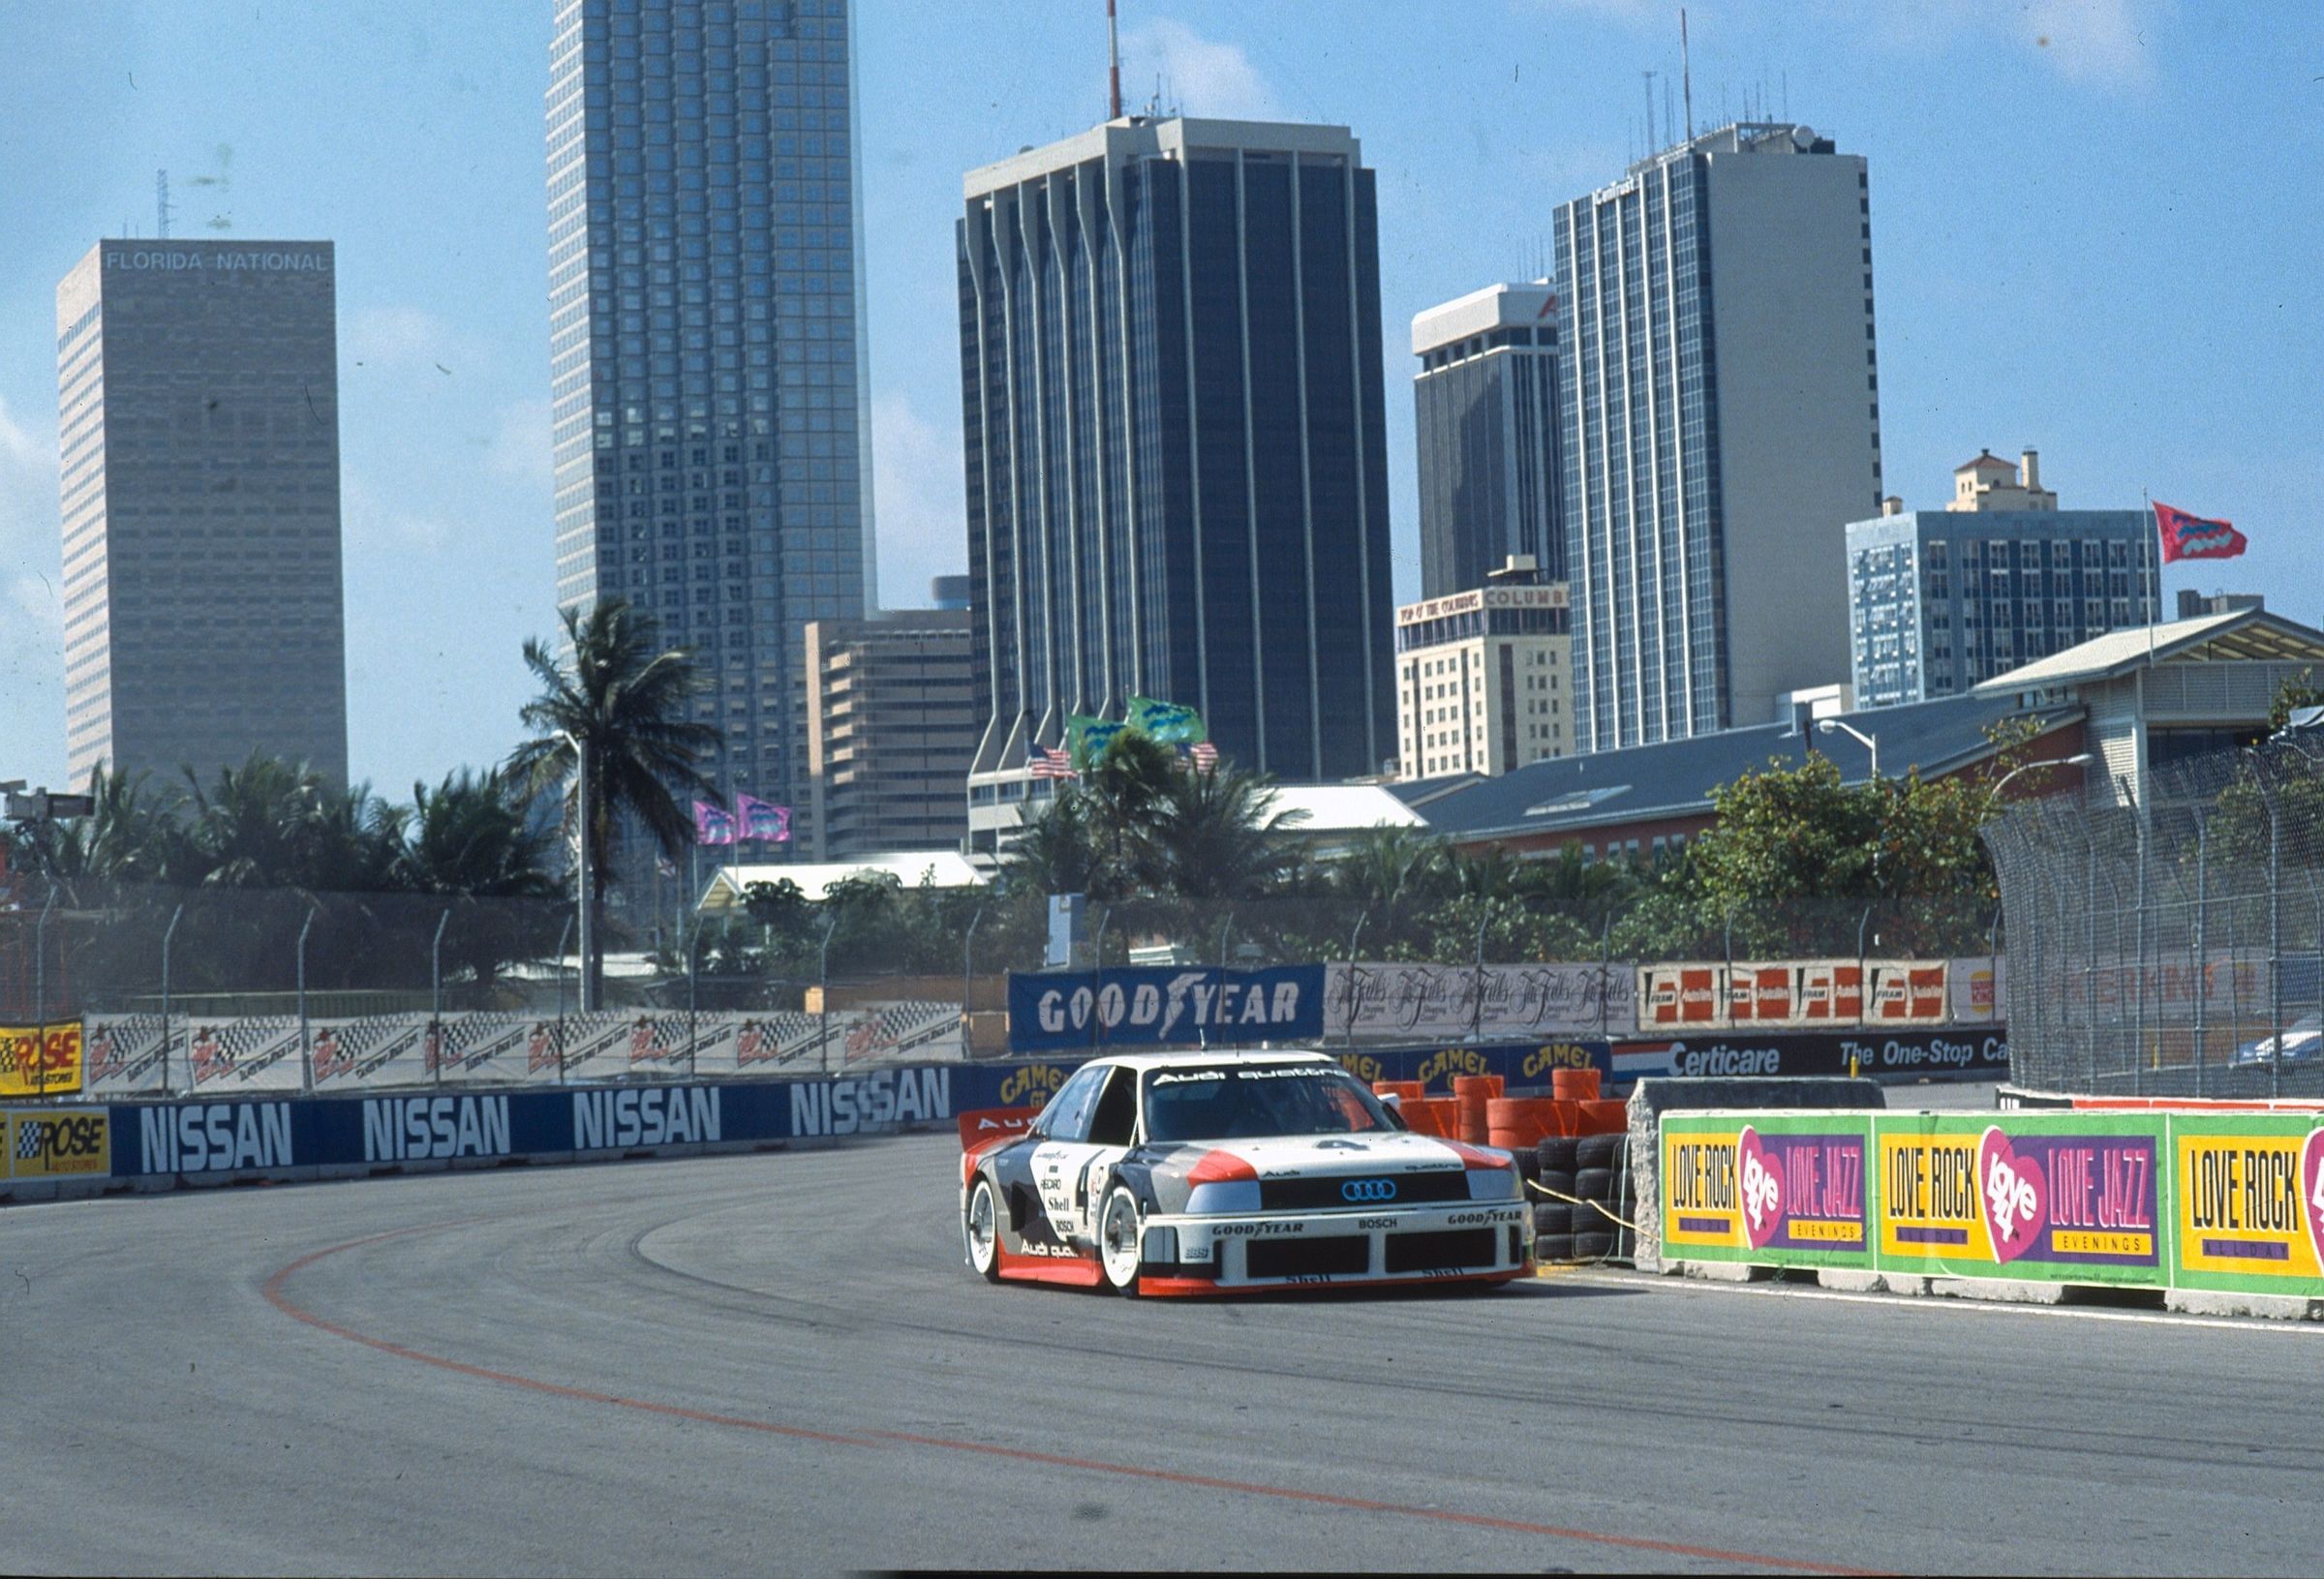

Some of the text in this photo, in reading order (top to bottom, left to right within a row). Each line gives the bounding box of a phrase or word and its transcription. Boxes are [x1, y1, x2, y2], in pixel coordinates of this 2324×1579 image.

[106, 252, 328, 272] FLORIDA NATIONAL
[1484, 590, 1570, 605] COLUMB
[1651, 993, 1673, 1004] FRAM
[1803, 989, 1826, 999] FRAM
[1876, 989, 1903, 999] FRAM
[15, 1031, 80, 1085] ROSE
[1419, 1050, 1491, 1083] CAMEL
[1523, 1044, 1596, 1078] CAMEL
[1667, 1042, 1780, 1077] Certicare
[1841, 1042, 1873, 1065] The
[1883, 1040, 1973, 1067] One-Stop
[1000, 1064, 1070, 1105] CAME
[1152, 1068, 1350, 1086] Audi quattro
[789, 1068, 950, 1137] NISSAN
[573, 1087, 720, 1150] NISSAN
[140, 1102, 291, 1174] NISSAN
[363, 1096, 510, 1162] NISSAN
[39, 1116, 105, 1170] ROSE
[1262, 1169, 1300, 1177] Audi
[1673, 1144, 1736, 1210] LOVE ROCK
[1787, 1146, 1861, 1218] LOVE JAZZ
[1888, 1146, 1976, 1220] LOVE ROCK
[1040, 1178, 1061, 1191] RECARO
[2048, 1148, 2151, 1229] LOVE JAZZ
[2190, 1149, 2239, 1230] LOVE
[2244, 1149, 2298, 1232] ROCK
[1048, 1197, 1069, 1212] Shell
[1055, 1219, 1074, 1232] BOSCH
[1359, 1218, 1396, 1230] BOSCH
[1797, 1224, 1855, 1238] EVENINGS
[1021, 1238, 1048, 1257] Audi
[1184, 1246, 1209, 1260] BBS
[2064, 1235, 2141, 1252] EVENINGS
[1285, 1273, 1331, 1285] Shell
